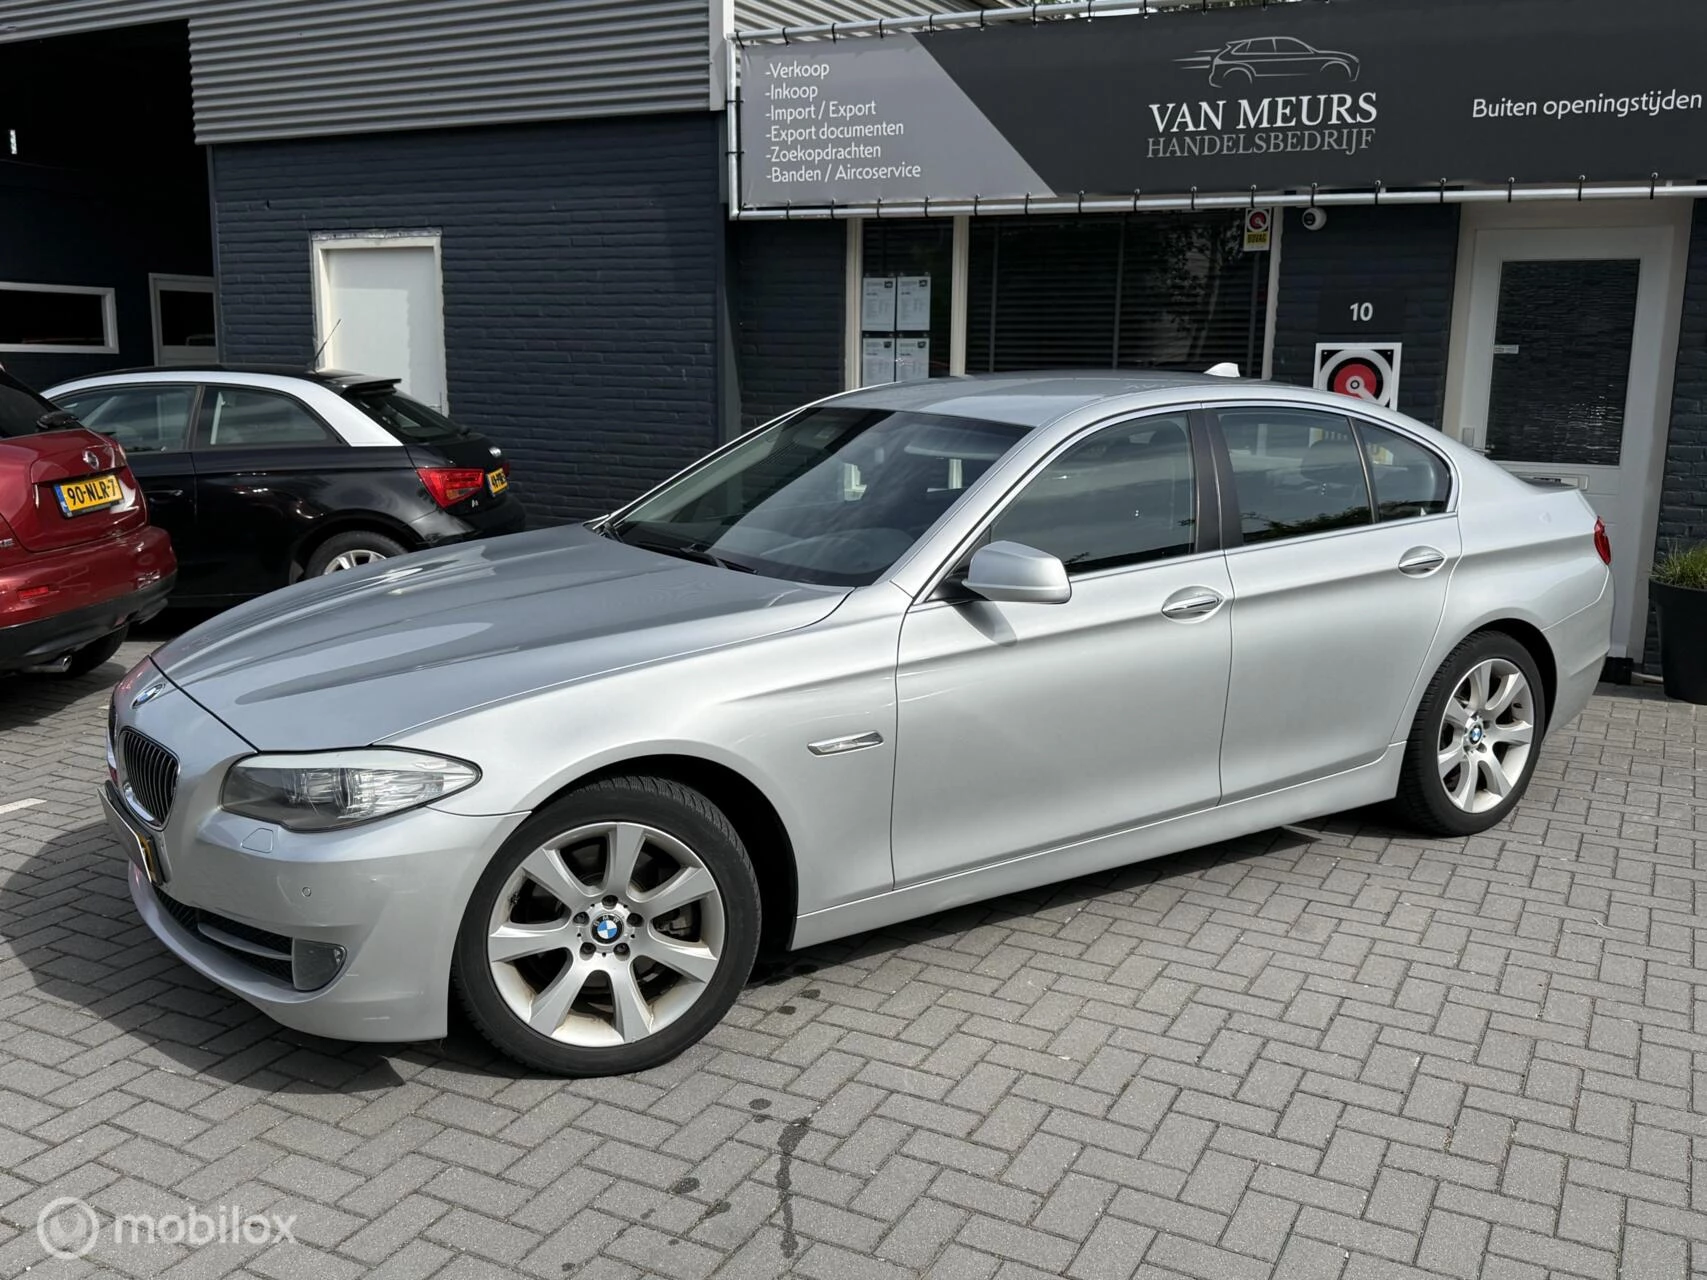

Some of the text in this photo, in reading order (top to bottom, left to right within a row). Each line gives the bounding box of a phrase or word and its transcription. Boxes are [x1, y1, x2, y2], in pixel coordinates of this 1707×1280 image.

[766, 61, 829, 79] -Verkoop
[765, 83, 818, 100] -Inkoop
[766, 104, 816, 124] -Import
[829, 101, 876, 120] Export
[1148, 91, 1379, 134] VAN MEURS
[1472, 89, 1703, 120] Buiten openingstijden
[766, 122, 904, 145] -Export documenten
[1146, 127, 1376, 159] HANDELSBEDRIJF
[766, 143, 881, 163] -Zoekopdrachten
[765, 164, 822, 183] -Banden
[835, 162, 921, 180] Aircoservice
[1349, 301, 1374, 322] 10
[66, 479, 116, 506] 90-NLR-7
